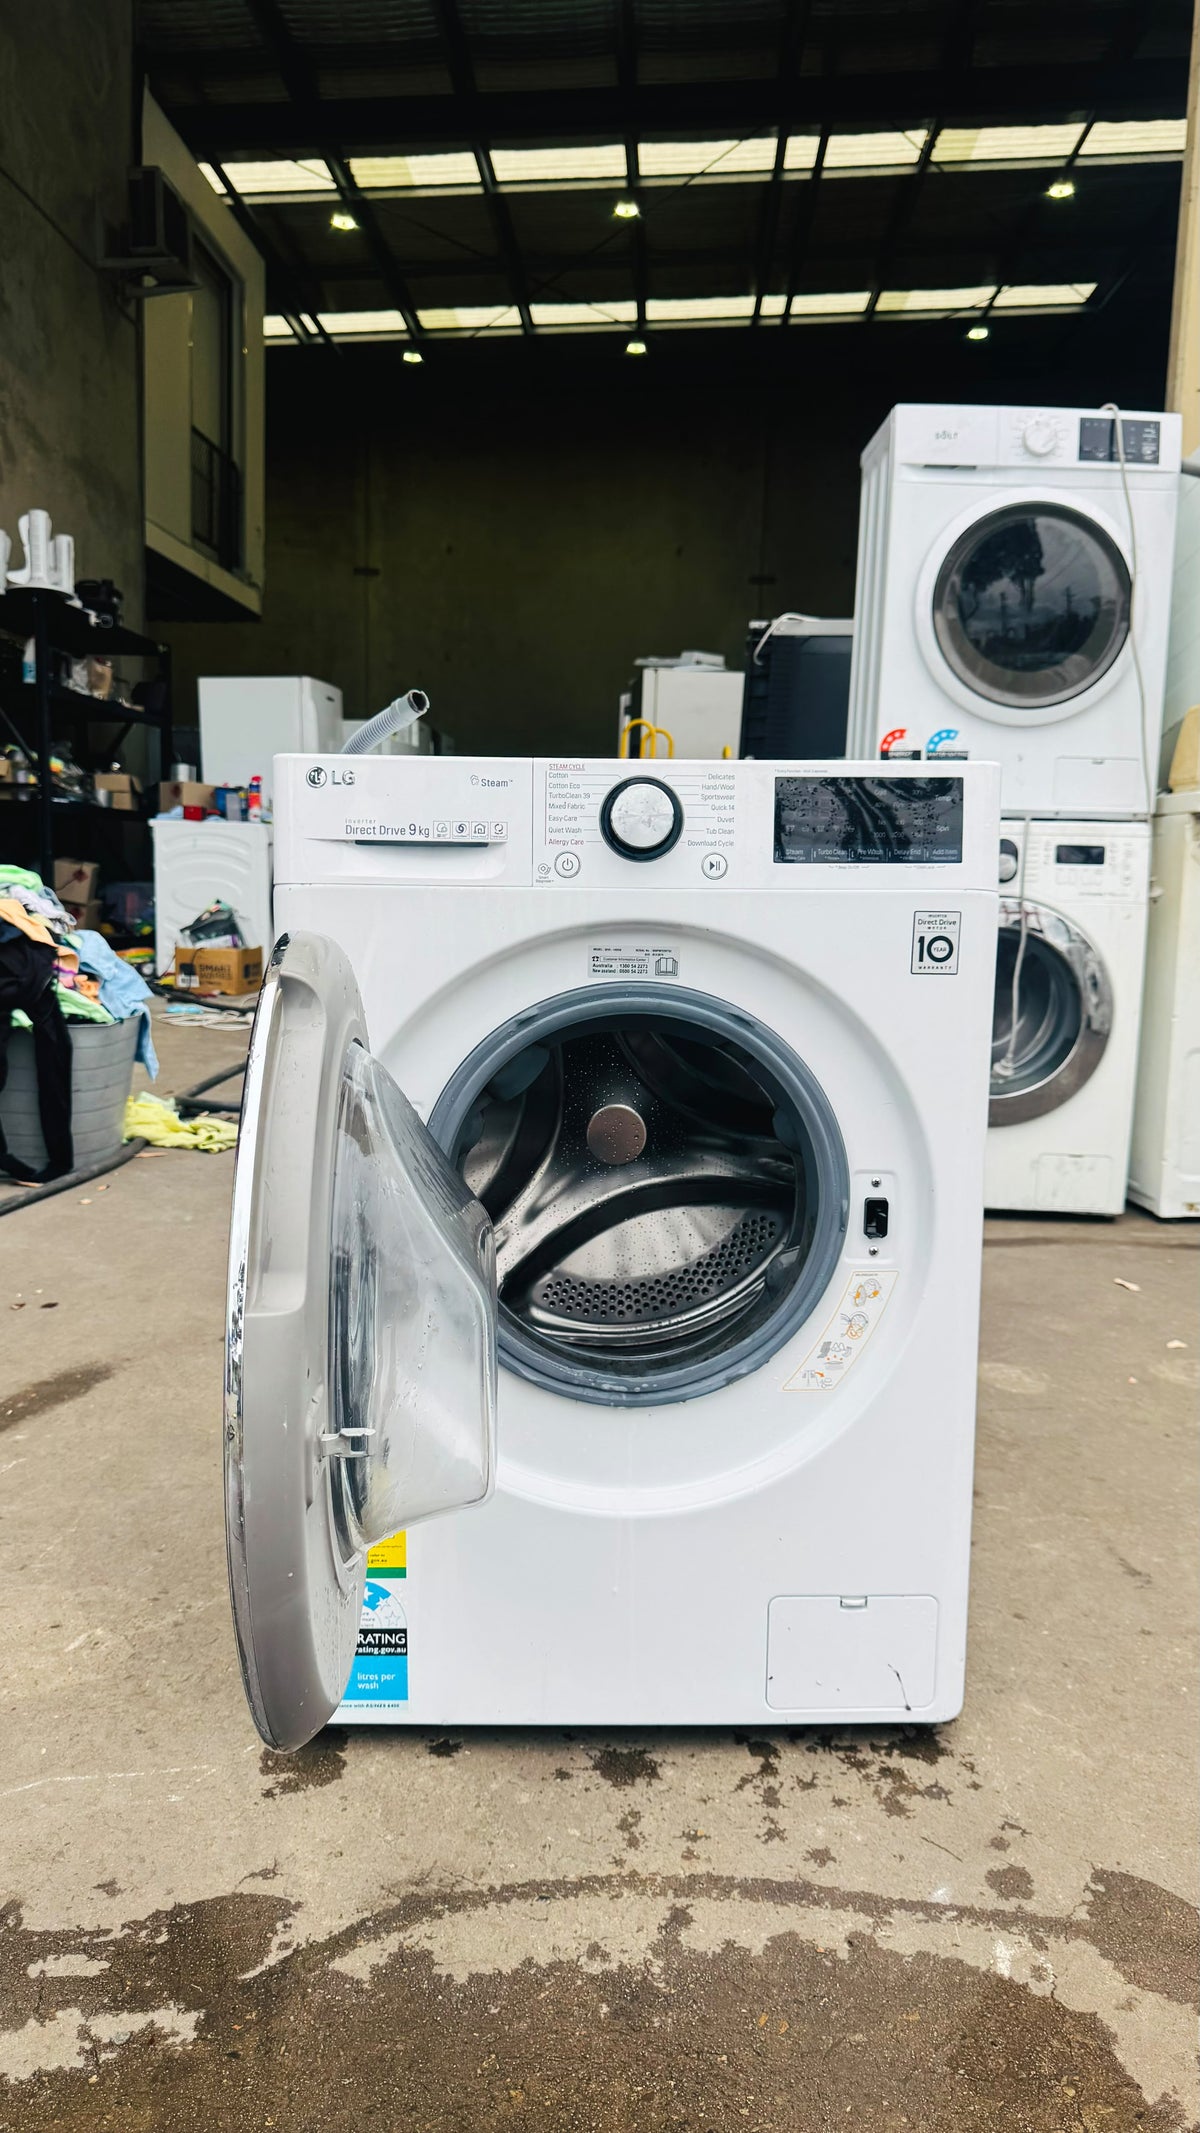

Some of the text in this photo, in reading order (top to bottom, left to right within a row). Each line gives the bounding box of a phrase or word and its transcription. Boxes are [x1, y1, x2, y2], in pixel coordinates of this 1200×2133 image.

[331, 770, 356, 786] LG
[701, 793, 735, 801] Sportswear
[935, 794, 952, 802] Temp
[549, 802, 566, 810] Mixed
[345, 824, 377, 836] Direct
[379, 824, 406, 836] Drive
[409, 824, 417, 836] 9
[418, 824, 430, 838] kg
[548, 838, 584, 846] Allergy Care
[718, 840, 734, 848] Cycle
[917, 935, 954, 963] 10
[358, 1633, 406, 1644] RATING
[357, 1672, 396, 1683] litres per
[357, 1681, 379, 1690] wash
